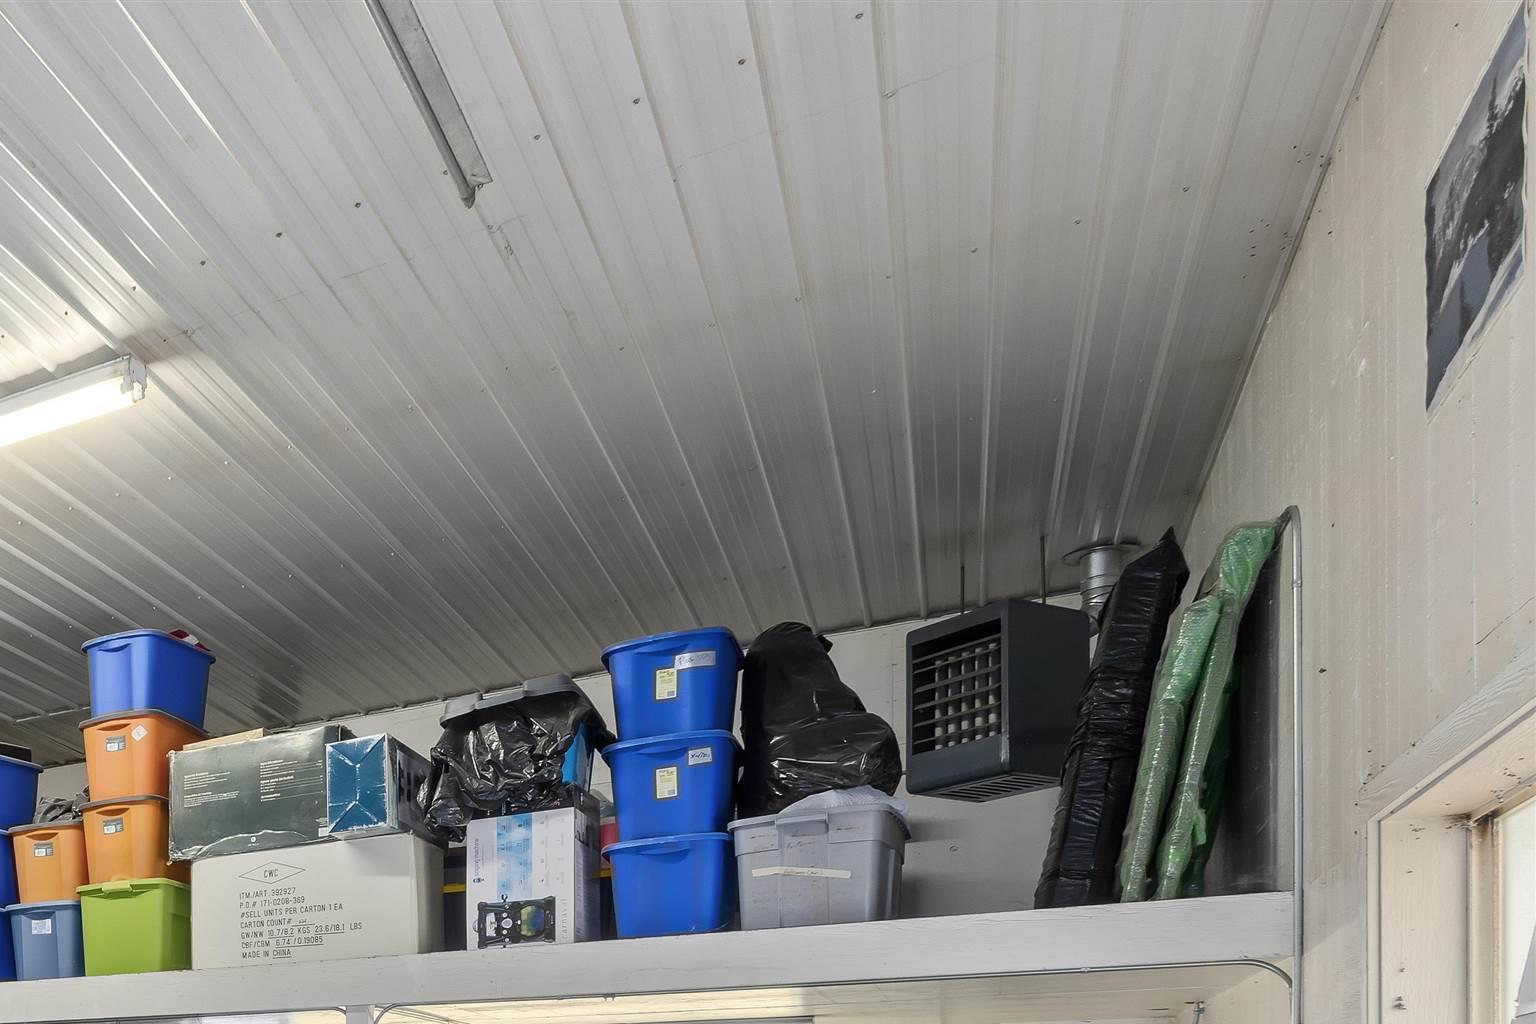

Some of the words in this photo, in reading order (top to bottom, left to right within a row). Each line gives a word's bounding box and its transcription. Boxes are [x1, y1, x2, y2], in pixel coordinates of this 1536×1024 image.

[263, 868, 279, 879] CWC
[264, 908, 283, 917] UNITS
[285, 907, 298, 915] PER
[300, 904, 326, 914] CARTON
[240, 920, 265, 929] CARTON
[297, 926, 311, 934] KGS
[349, 922, 363, 931] LBS
[242, 951, 260, 959] MADE
[263, 950, 269, 958] IN
[273, 949, 291, 957] CHINA
